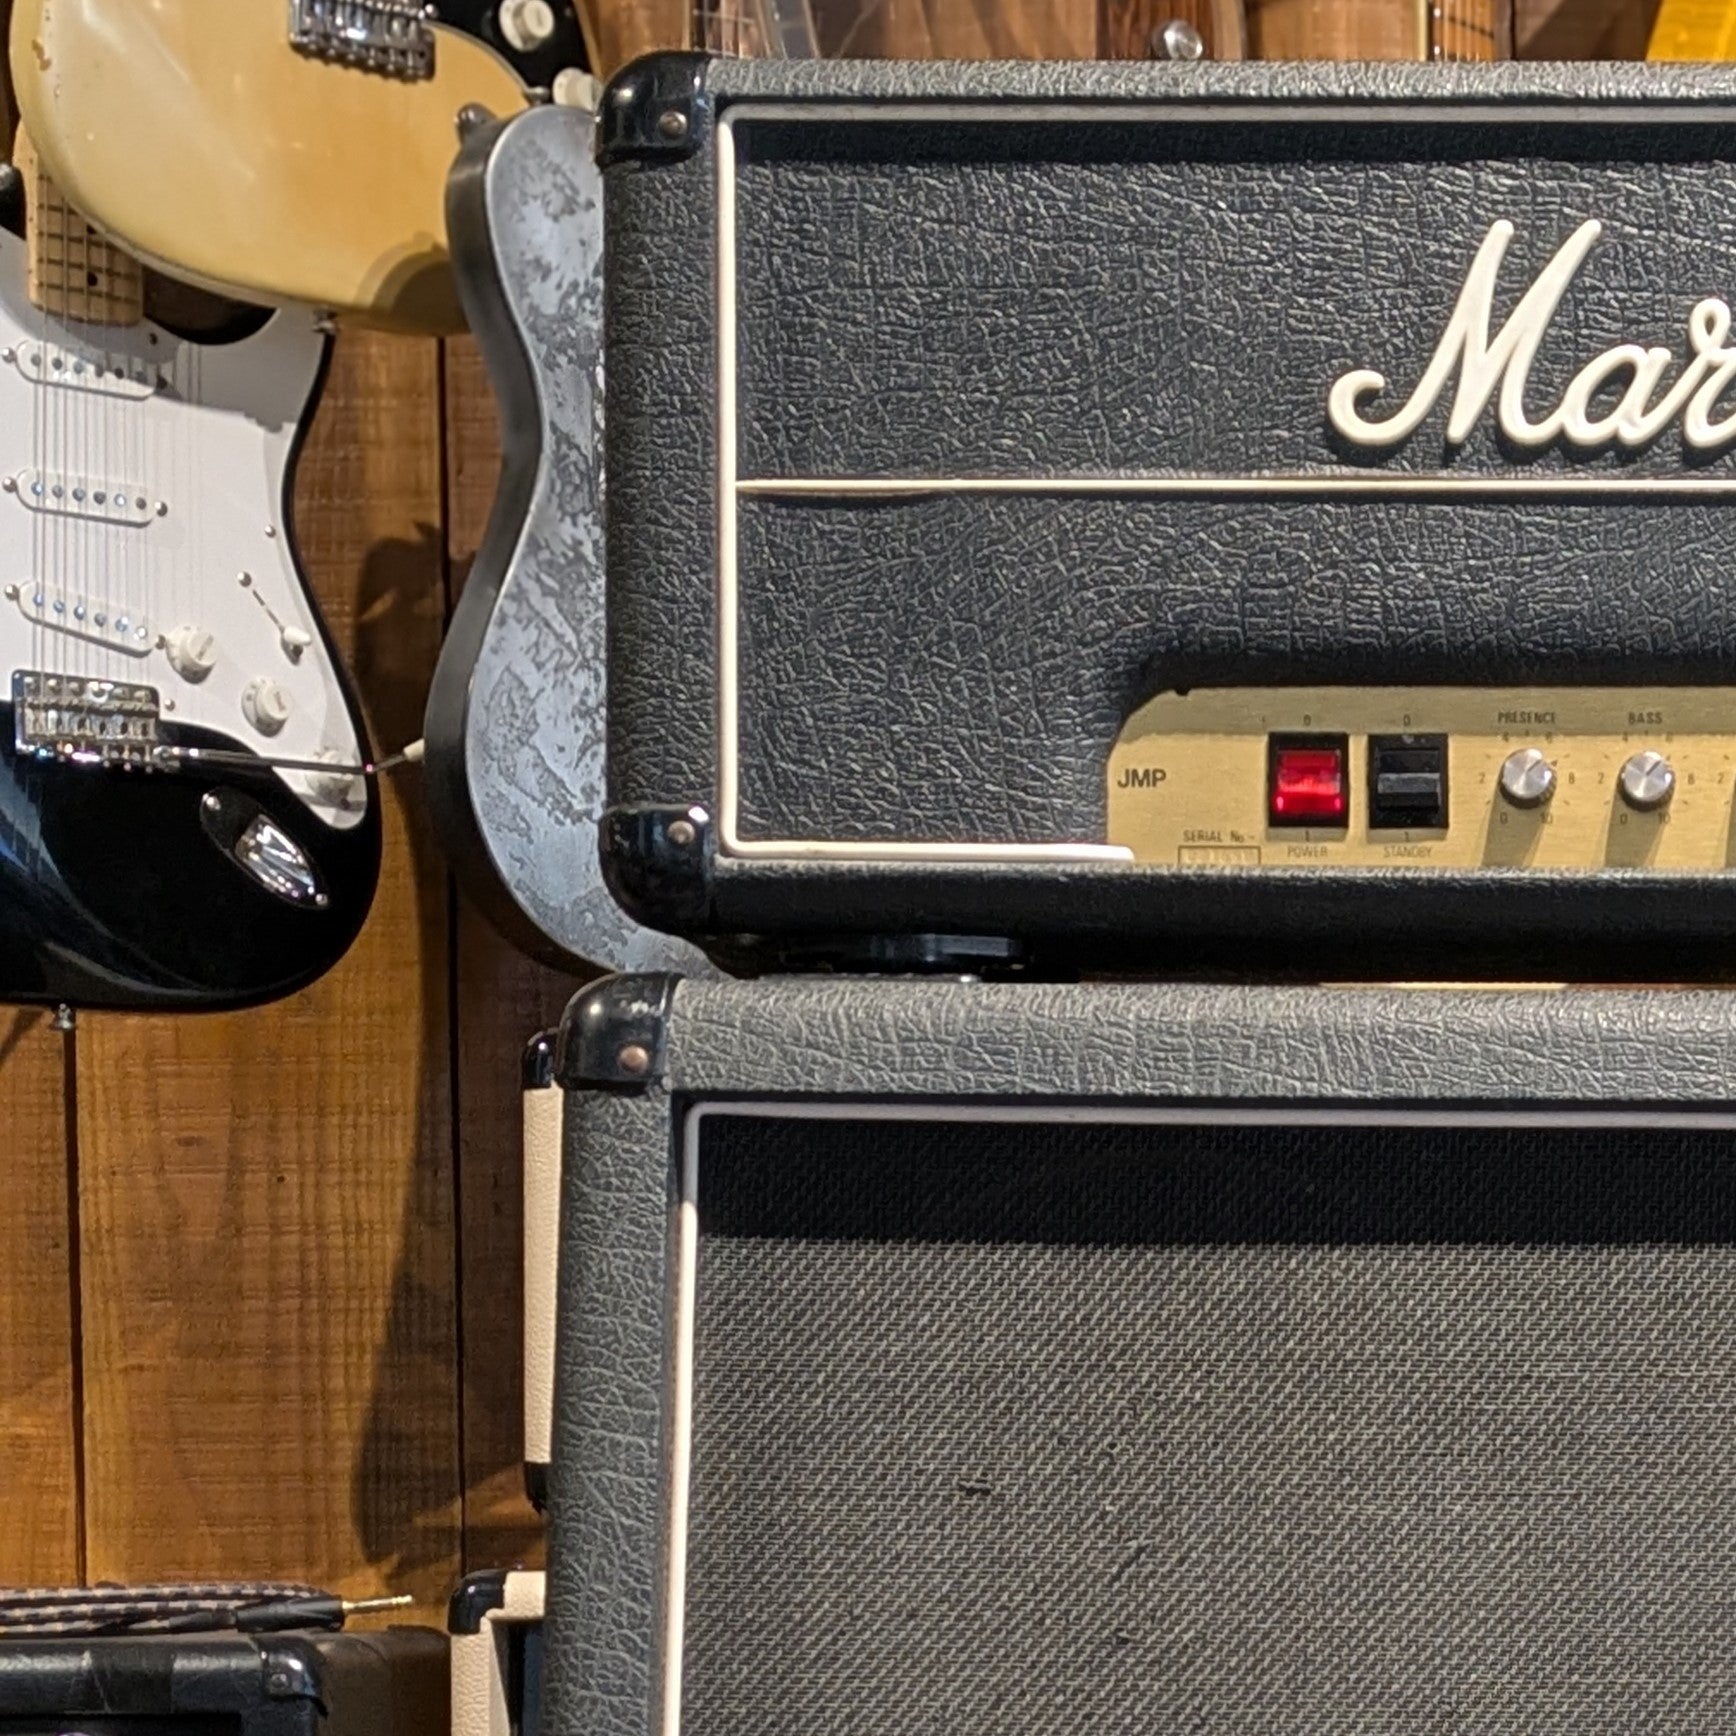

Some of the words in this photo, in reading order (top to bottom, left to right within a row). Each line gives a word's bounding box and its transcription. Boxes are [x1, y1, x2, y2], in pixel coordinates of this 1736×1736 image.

[1498, 711, 1556, 723] PRESENCE
[1628, 711, 1663, 724] BASS
[1117, 768, 1167, 788] JMP
[1183, 830, 1224, 843] SERIAL
[1287, 845, 1328, 857] POWER
[1383, 845, 1432, 857] STANDBY
